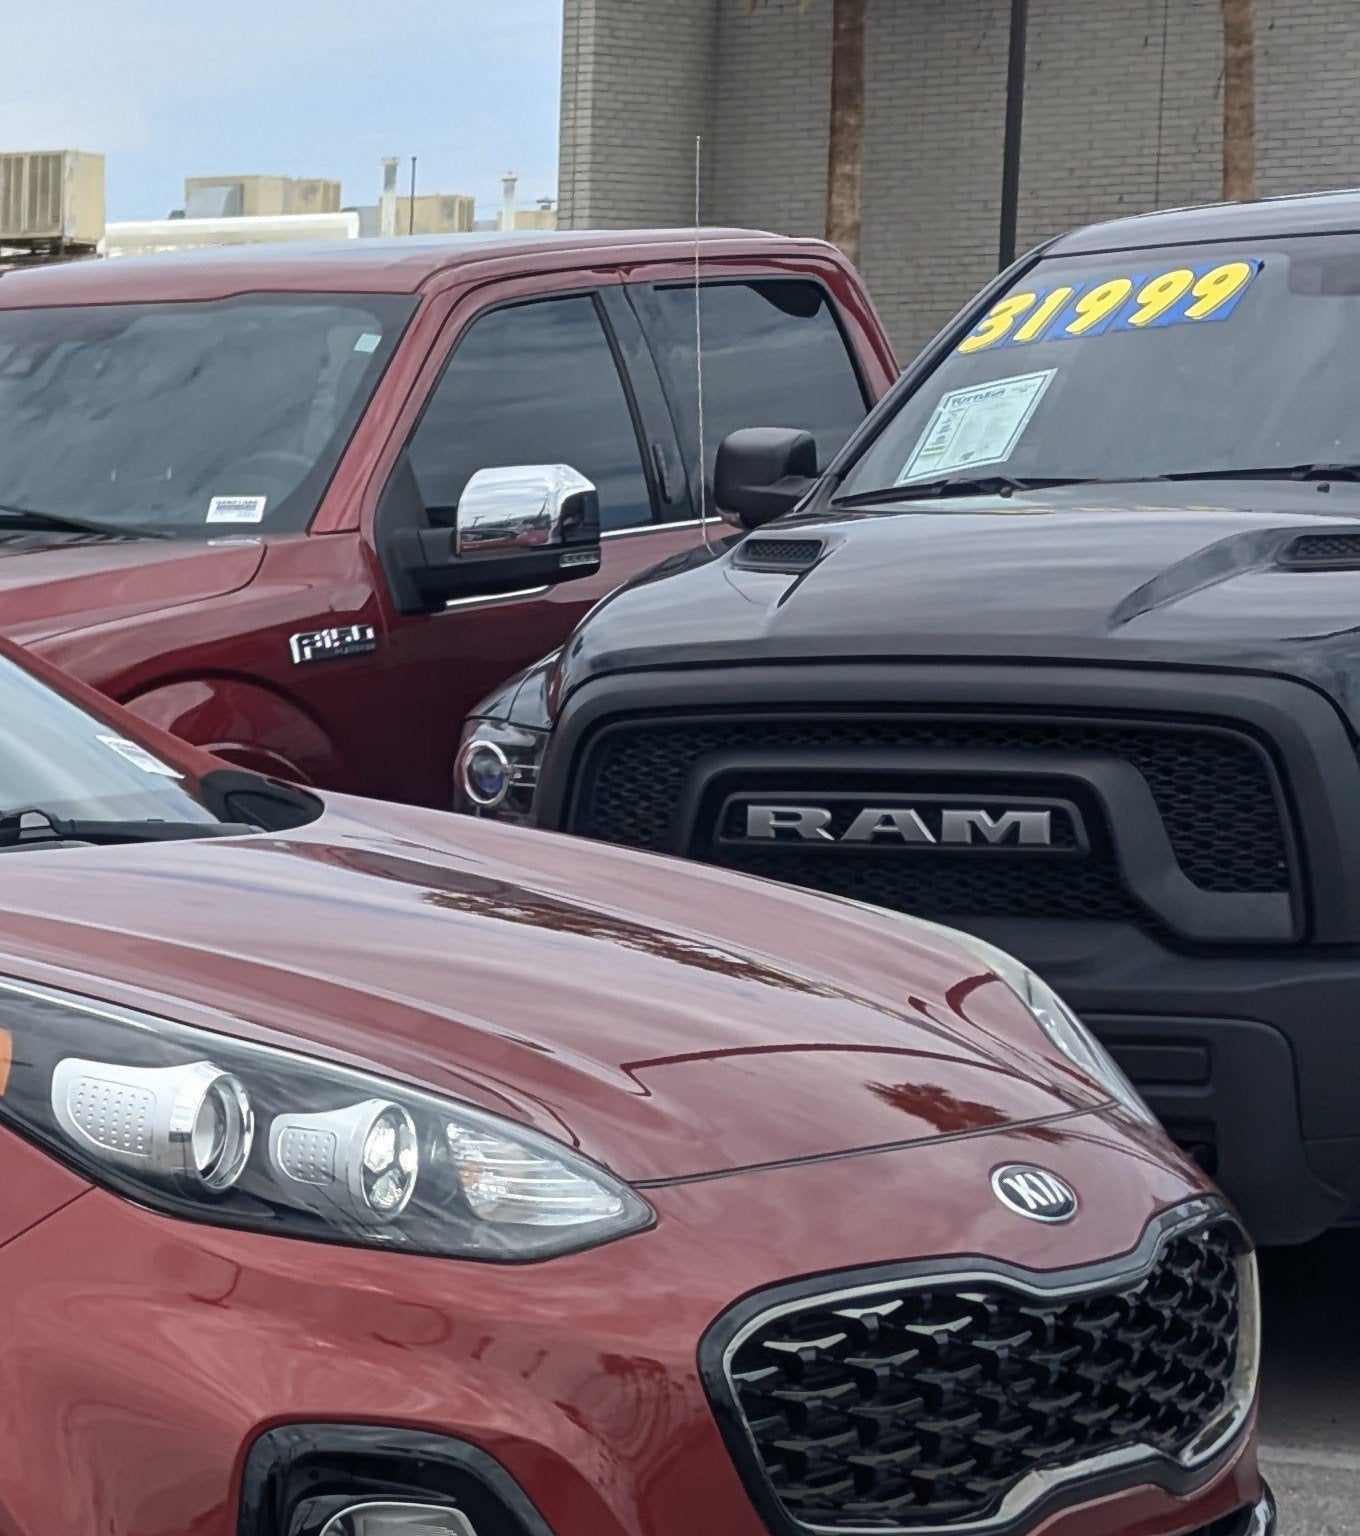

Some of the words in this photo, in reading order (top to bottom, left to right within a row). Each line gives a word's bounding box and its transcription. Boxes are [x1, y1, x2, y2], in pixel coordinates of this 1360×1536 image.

[957, 262, 1252, 353] 31999
[747, 804, 1051, 845] RAM
[1002, 1171, 1074, 1210] KIA
